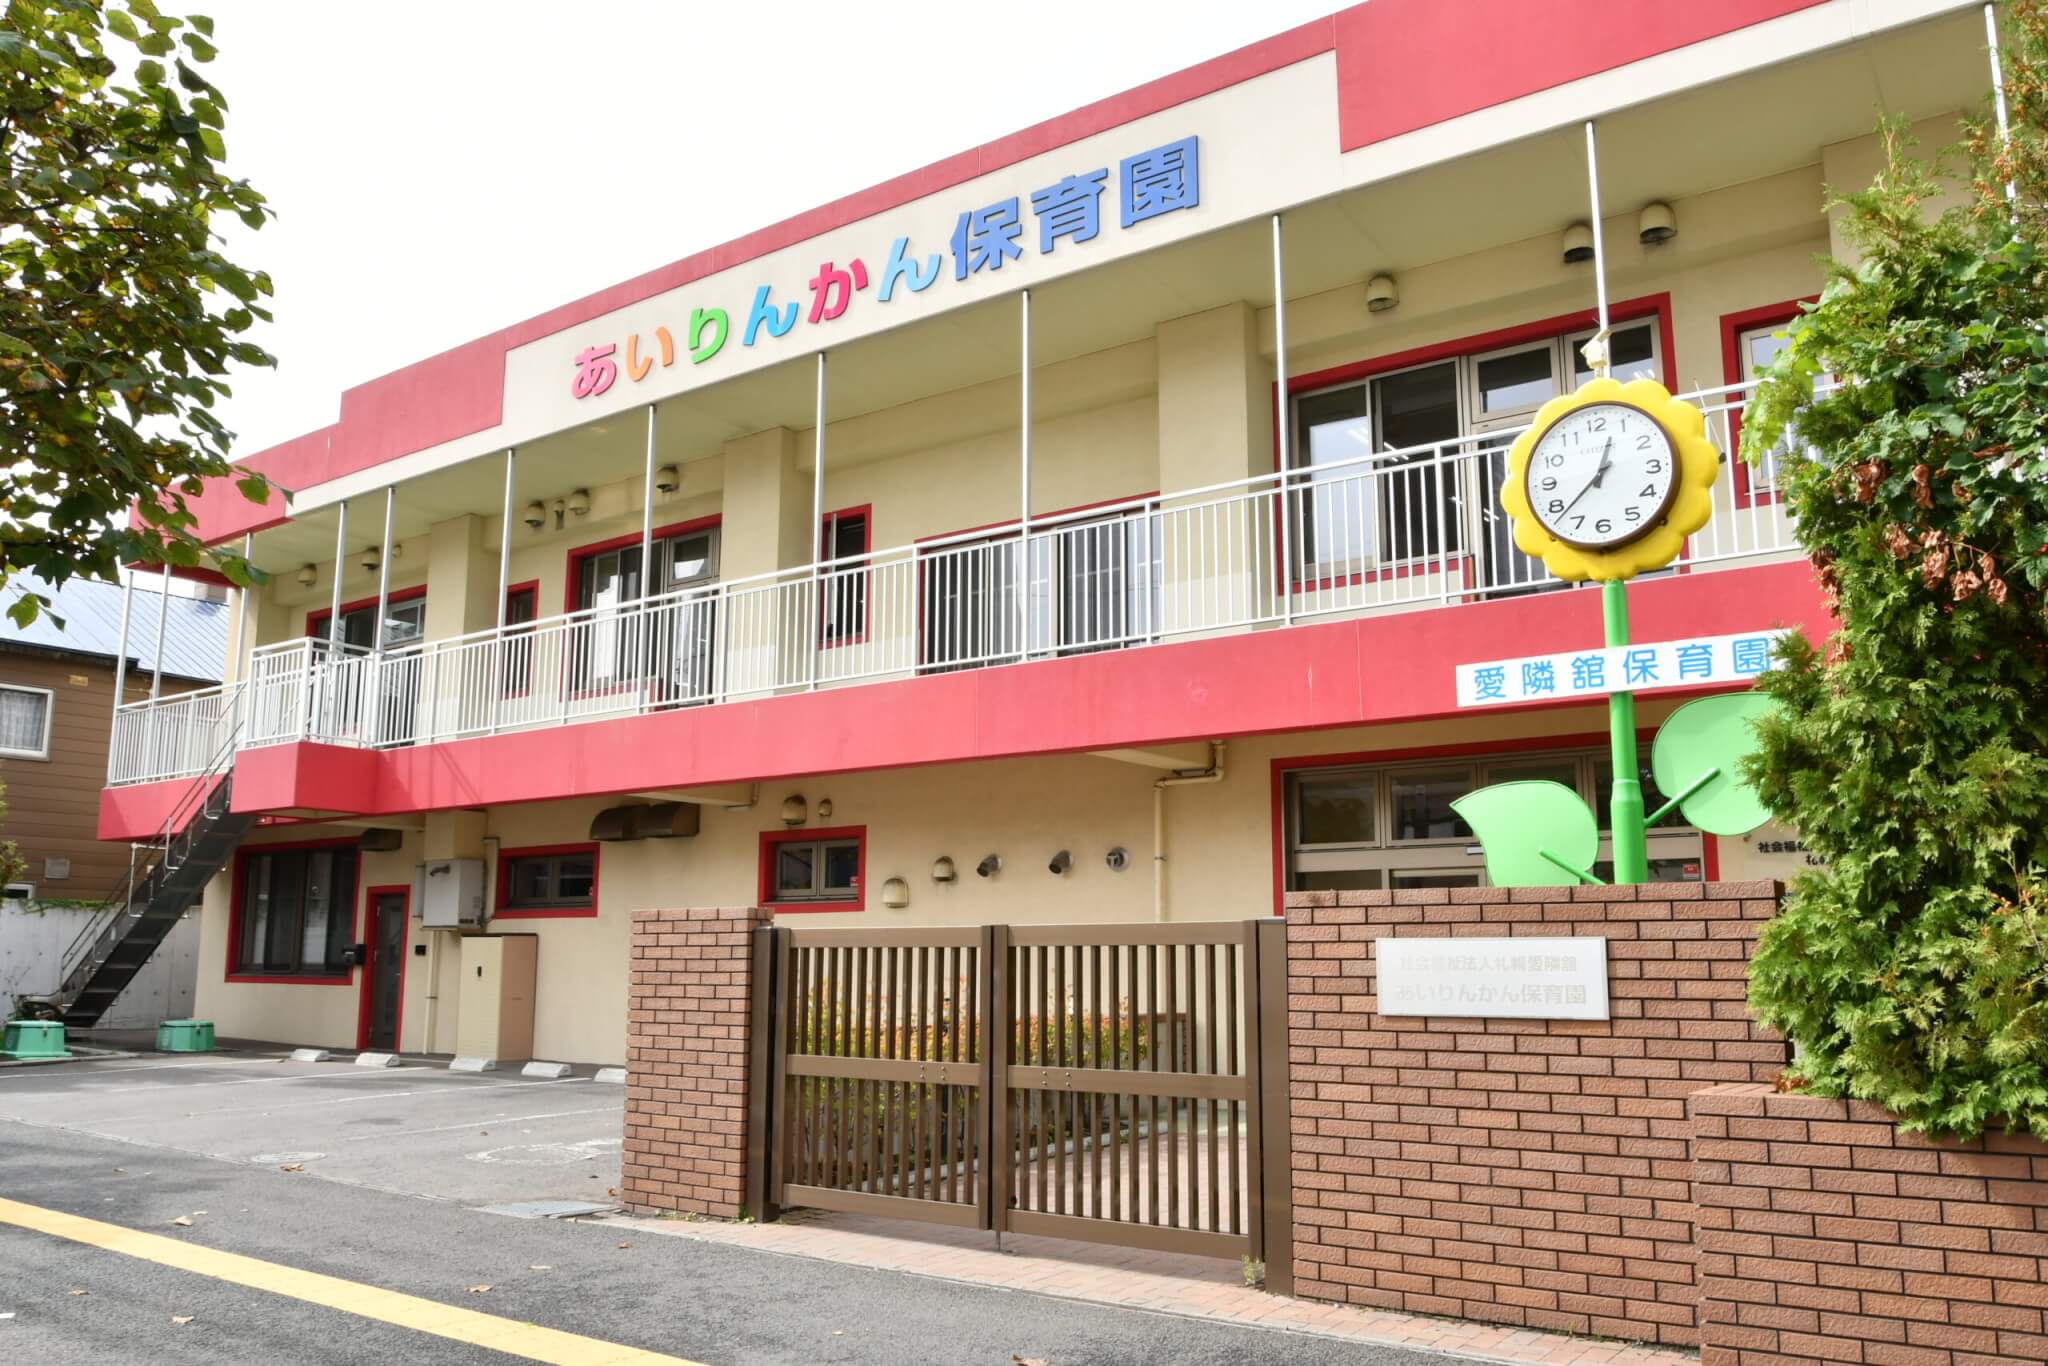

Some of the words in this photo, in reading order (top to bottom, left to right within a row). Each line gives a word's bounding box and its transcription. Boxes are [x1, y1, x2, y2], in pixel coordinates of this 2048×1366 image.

[571, 134, 1200, 399] あいりんかん保育園
[1587, 417, 1607, 433] 12
[1620, 418, 1627, 433] 1
[1561, 431, 1580, 448] 11
[1636, 435, 1651, 451] 2
[1544, 453, 1565, 470] 10
[1646, 459, 1662, 474] 3
[1541, 476, 1558, 491] 9
[1639, 483, 1657, 498] 4
[1549, 499, 1565, 514] 8
[1624, 506, 1641, 521] 5
[1570, 515, 1586, 530] 7
[1595, 519, 1612, 534] 6
[1758, 841, 1812, 853] 社会福祉
[1395, 983, 1587, 1005] あいりんかん保育園
